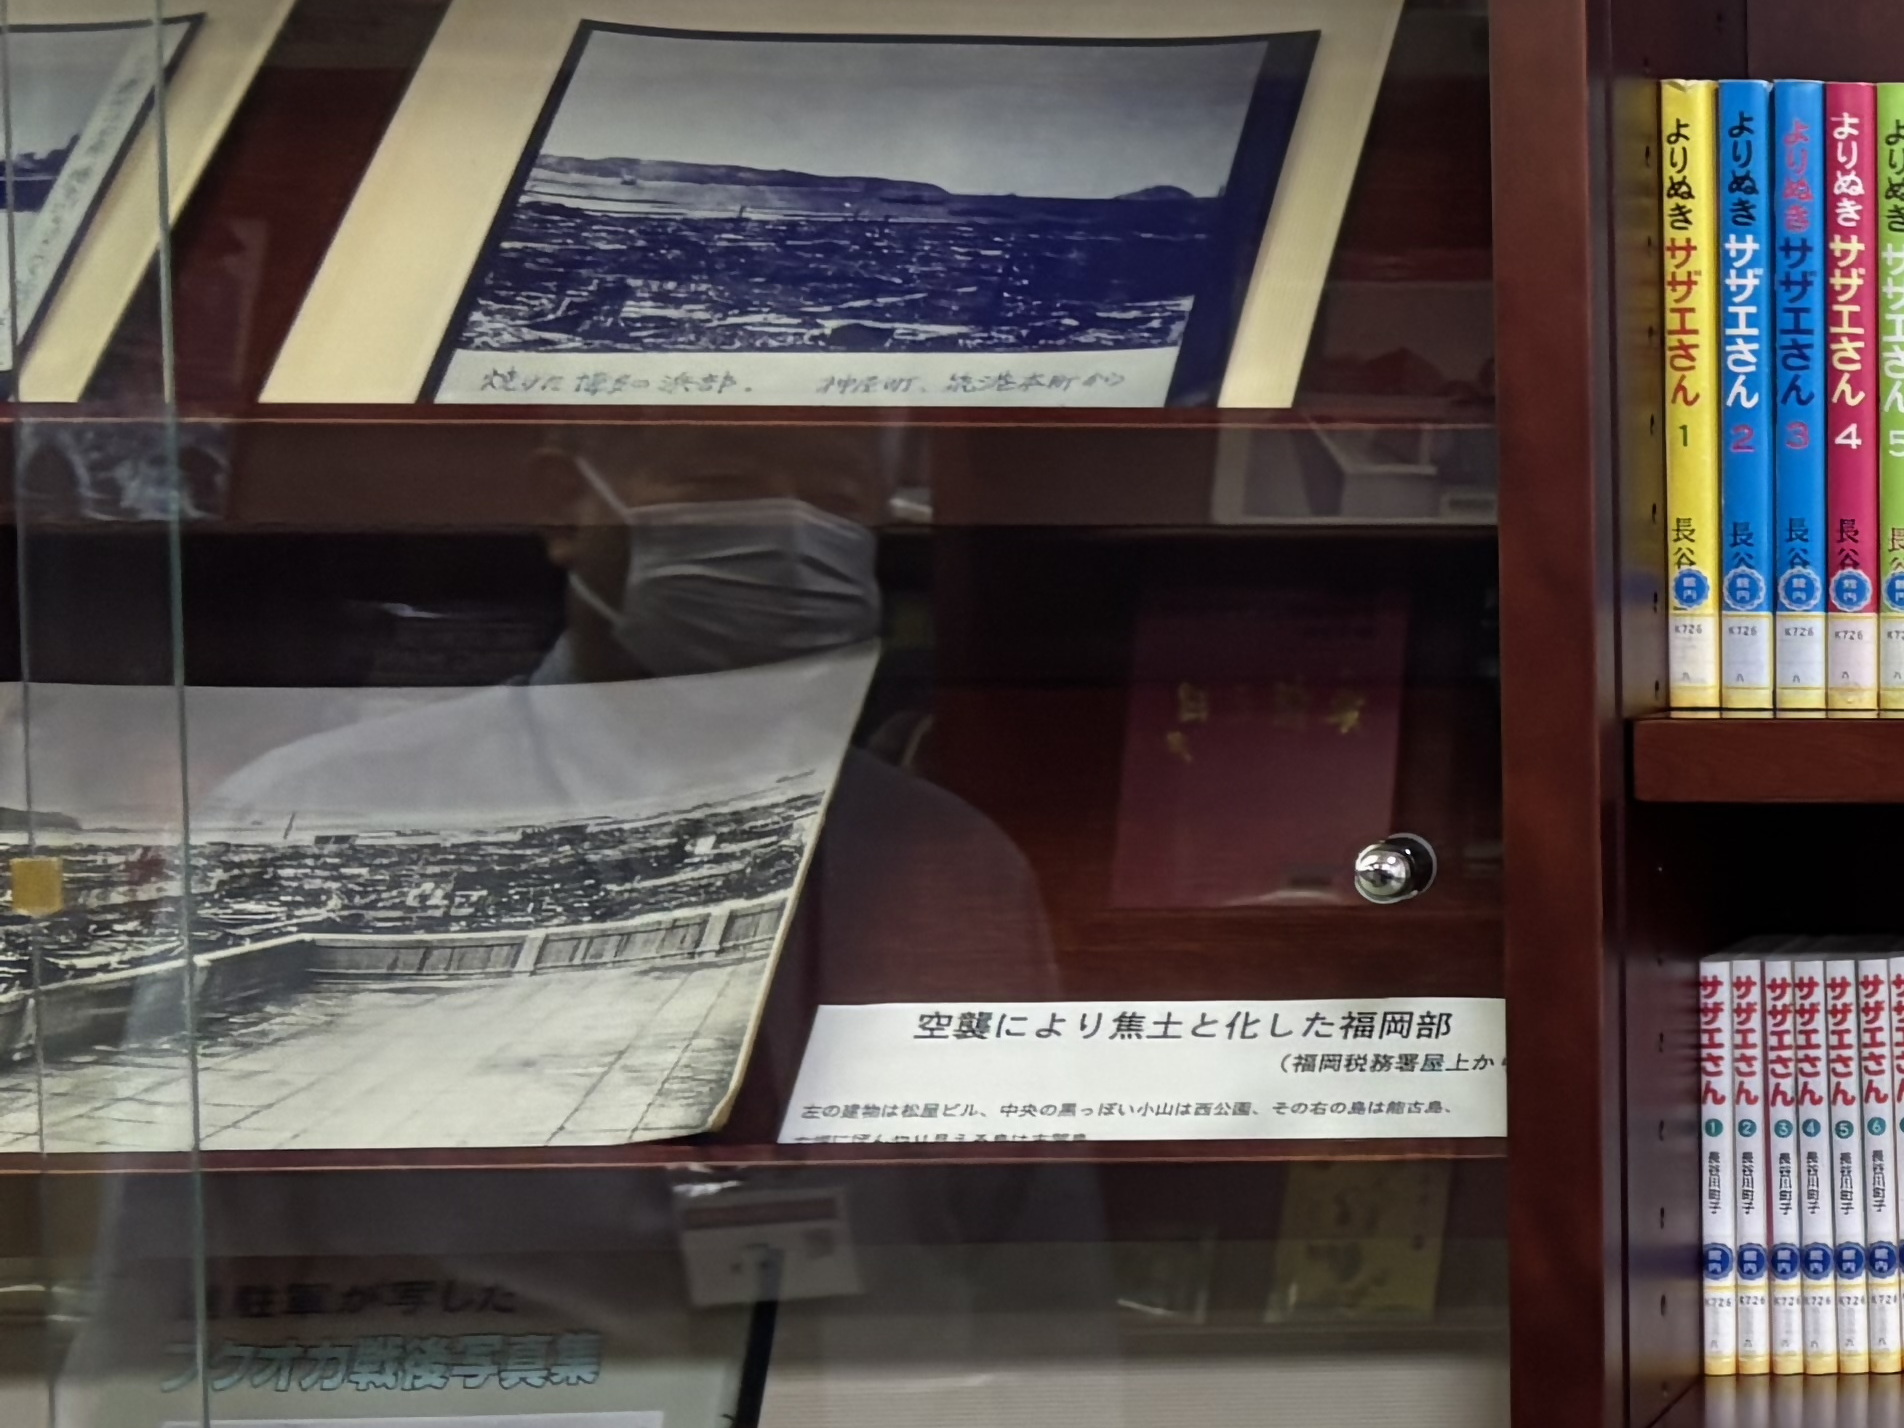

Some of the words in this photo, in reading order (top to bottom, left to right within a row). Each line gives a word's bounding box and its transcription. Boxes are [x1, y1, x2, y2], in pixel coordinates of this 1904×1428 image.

[1679, 425, 1689, 448] 1
[1730, 428, 1755, 452] 2
[1785, 424, 1810, 449] 3
[1834, 427, 1862, 450] 4
[914, 1010, 1454, 1041] 空襲により焦土と化した福岡部
[1701, 975, 1726, 1106] サザエさん
[1733, 975, 1759, 1106] サザエさん
[1767, 977, 1795, 1108] サザエさん
[1279, 1052, 1506, 1074] (福岡税務署屋上か
